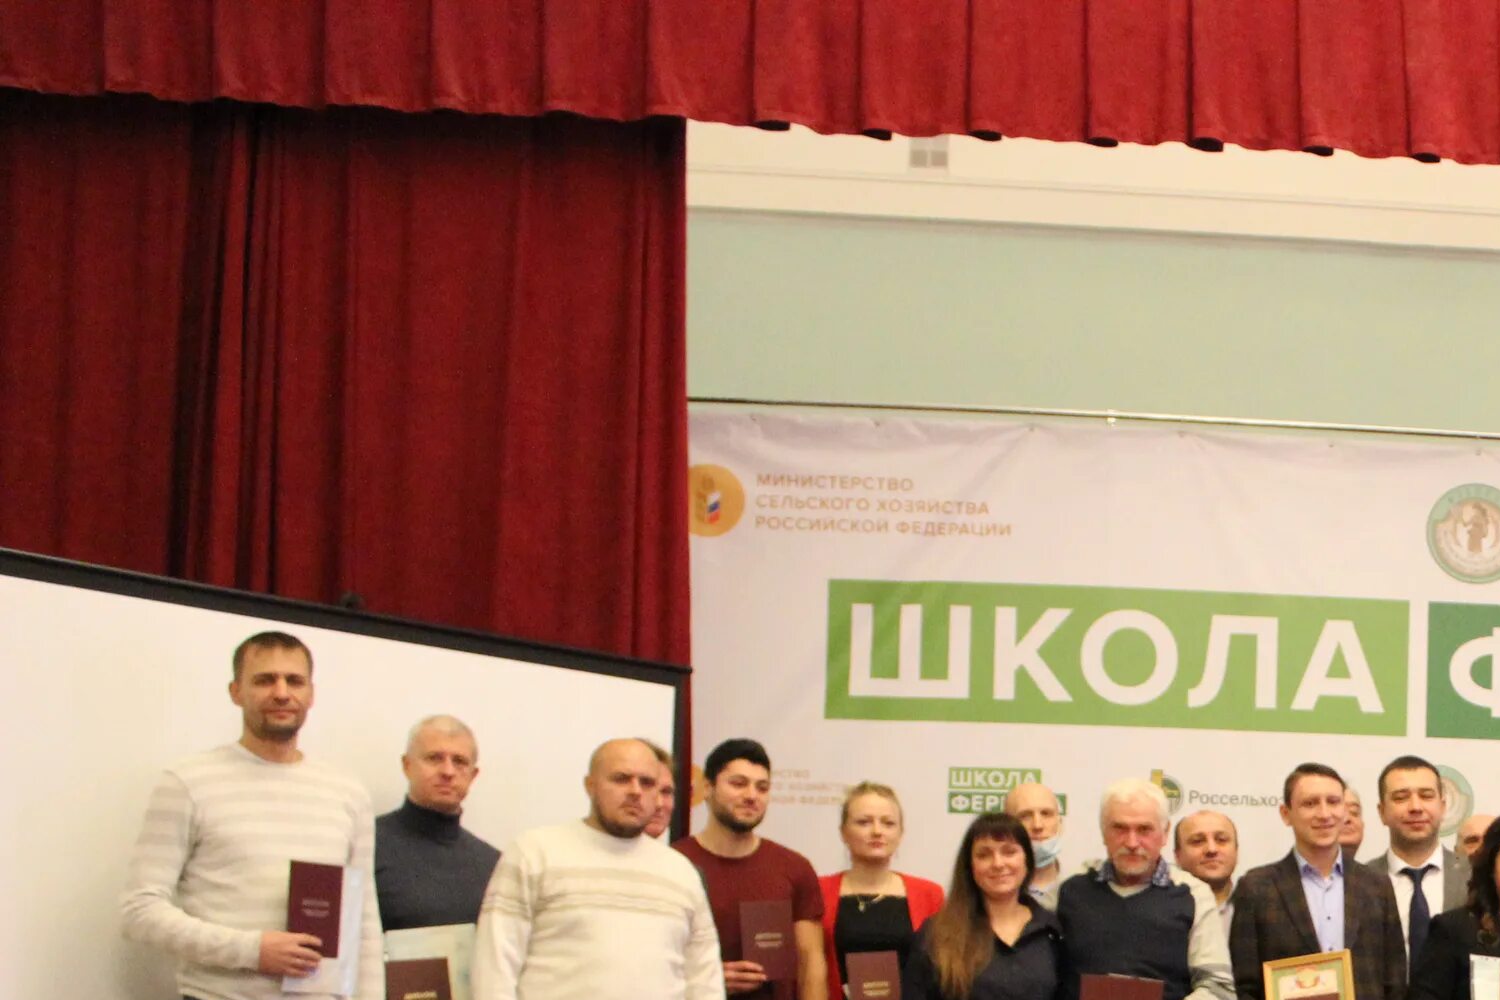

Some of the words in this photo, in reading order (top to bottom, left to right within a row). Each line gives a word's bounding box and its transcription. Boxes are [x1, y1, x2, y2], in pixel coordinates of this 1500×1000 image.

[756, 473, 914, 492] МИНИСТЕРСТВО
[755, 494, 870, 512] СЕЛЬСКОГО
[895, 520, 1012, 537] ФЕДЕРАЦИИ
[848, 602, 1386, 715] ШКОЛА
[951, 769, 1037, 787] ШКОЛА
